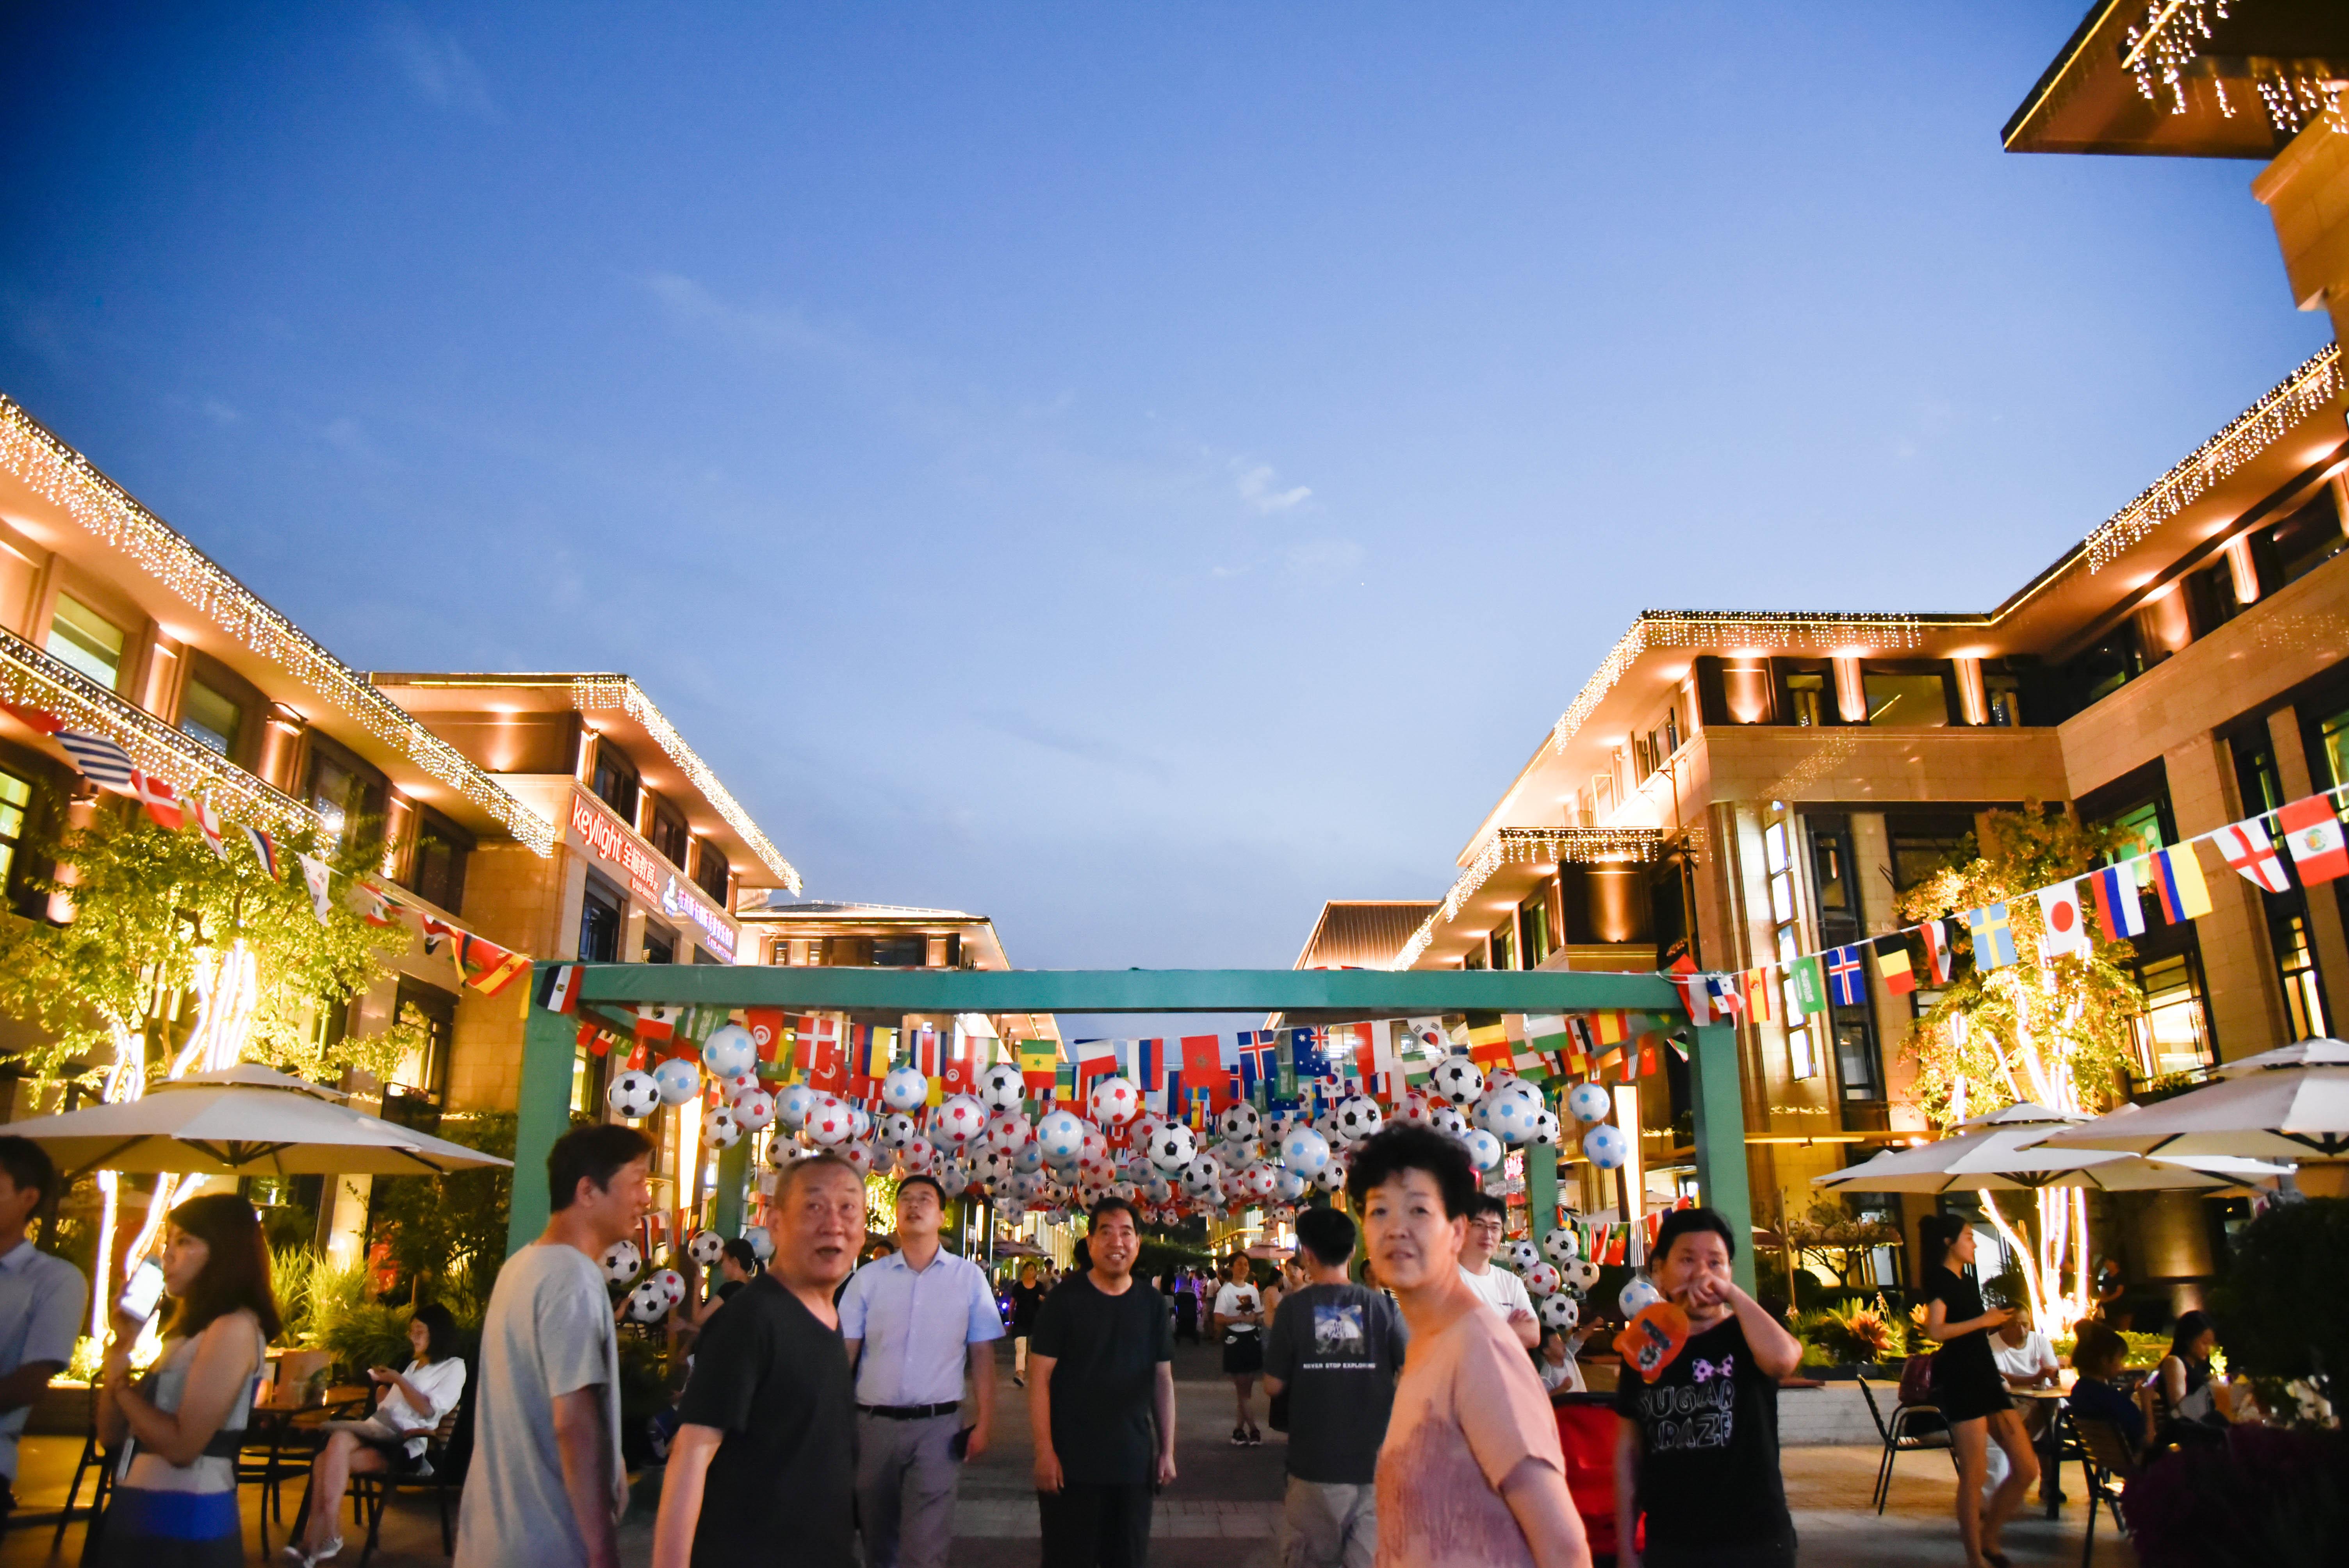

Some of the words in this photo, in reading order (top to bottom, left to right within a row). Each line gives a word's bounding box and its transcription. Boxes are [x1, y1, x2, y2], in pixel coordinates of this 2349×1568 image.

[572, 793, 622, 862] keylight
[622, 841, 656, 887] 全脑教育
